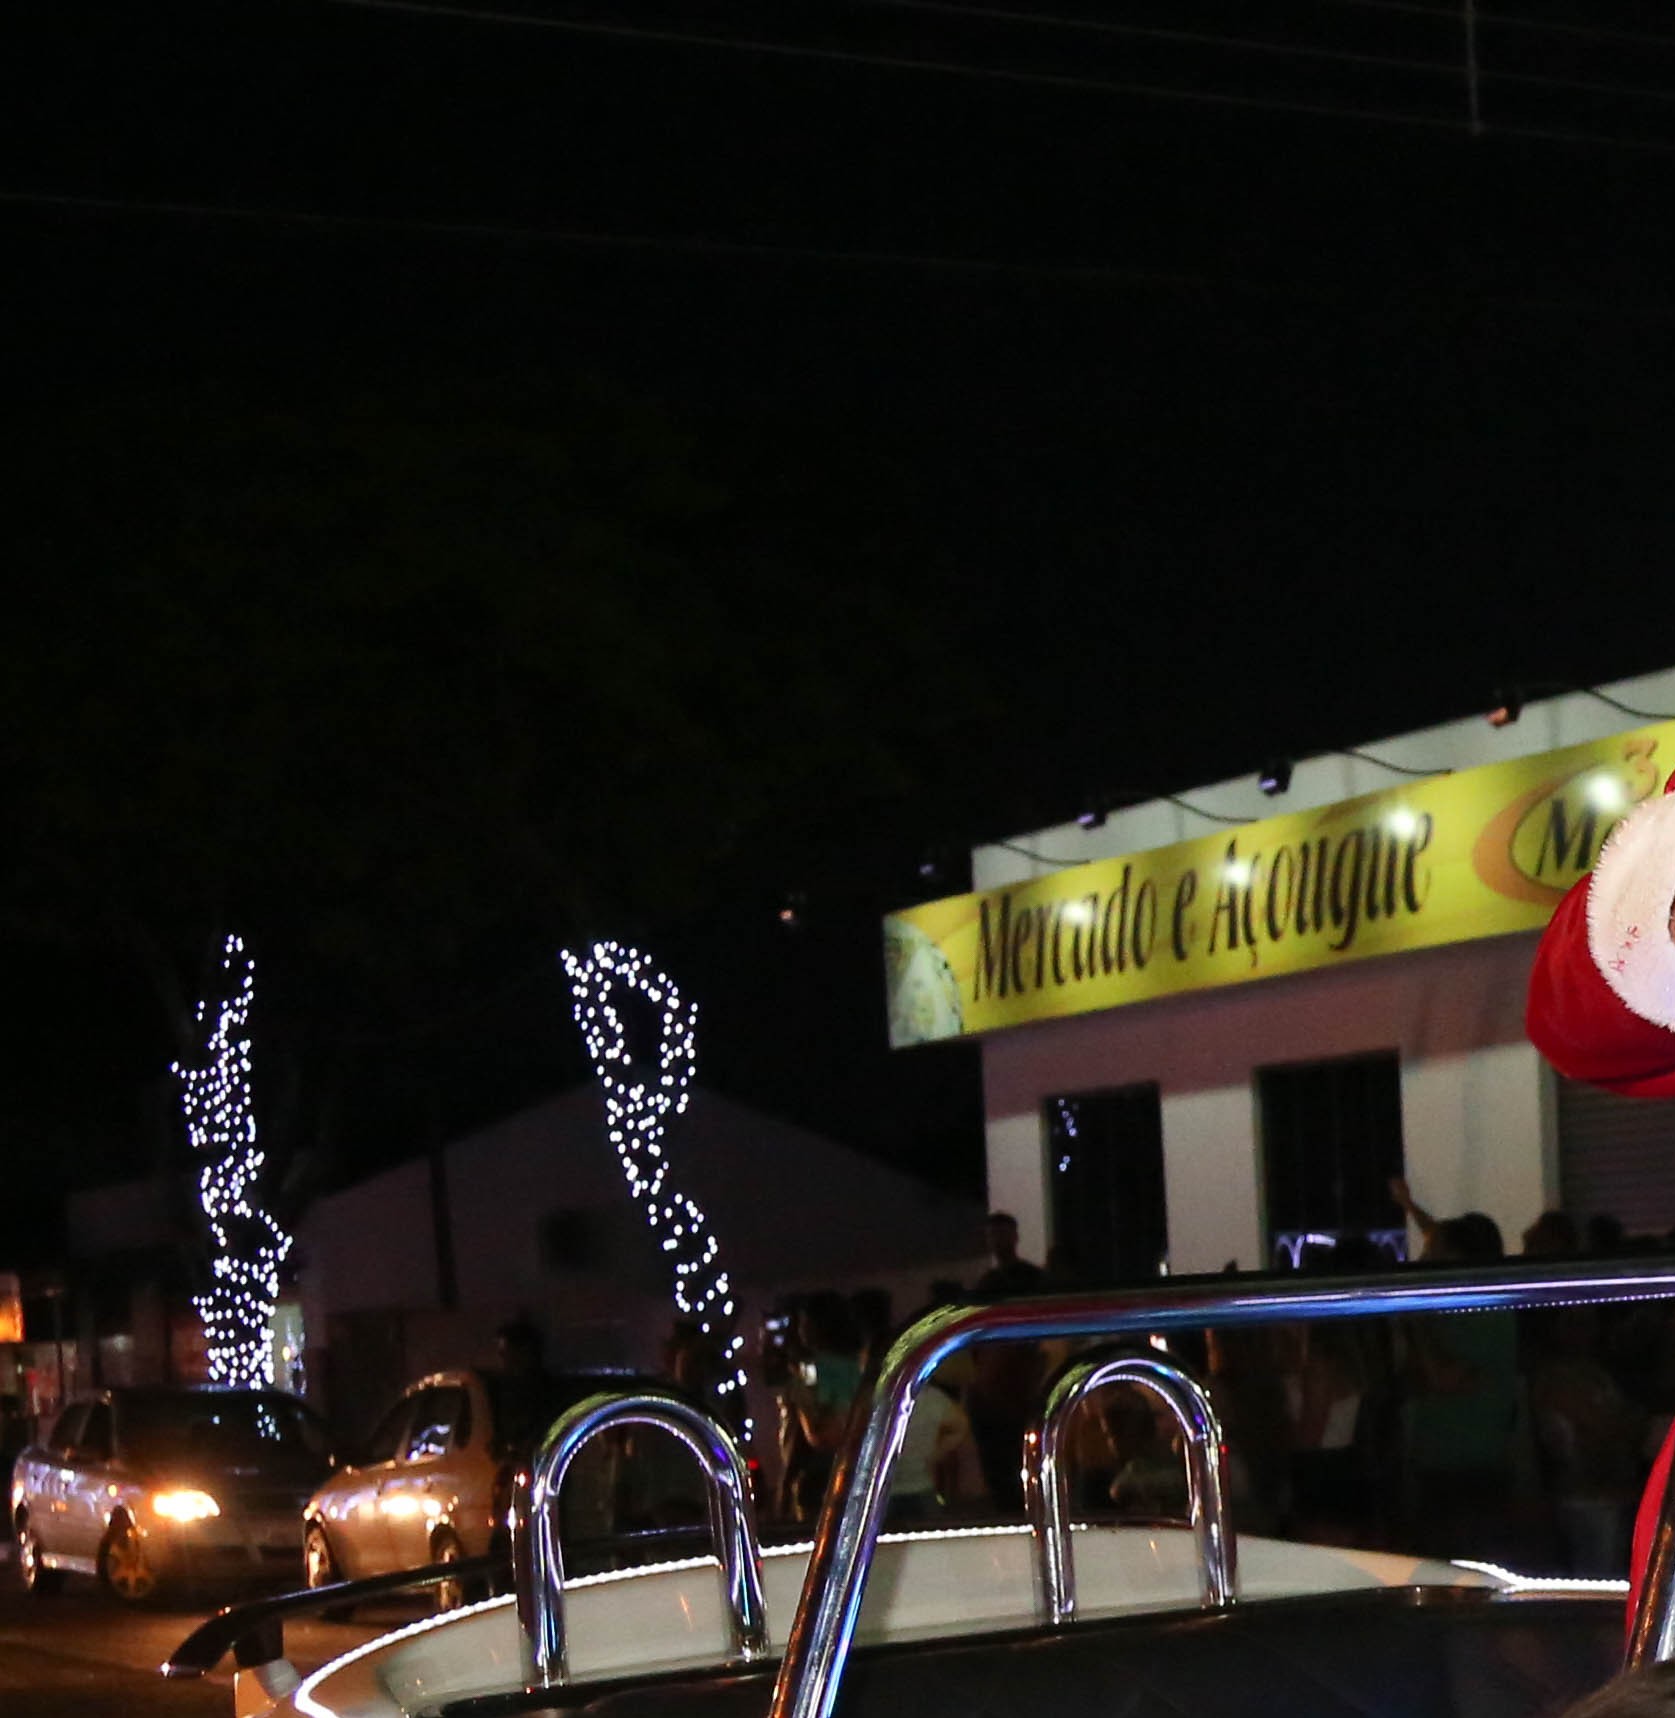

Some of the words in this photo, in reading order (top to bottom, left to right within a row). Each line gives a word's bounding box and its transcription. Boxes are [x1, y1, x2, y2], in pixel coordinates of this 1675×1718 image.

[974, 863, 1157, 1002] Mercado
[1172, 867, 1198, 962] e
[1208, 812, 1433, 969] Açougue
